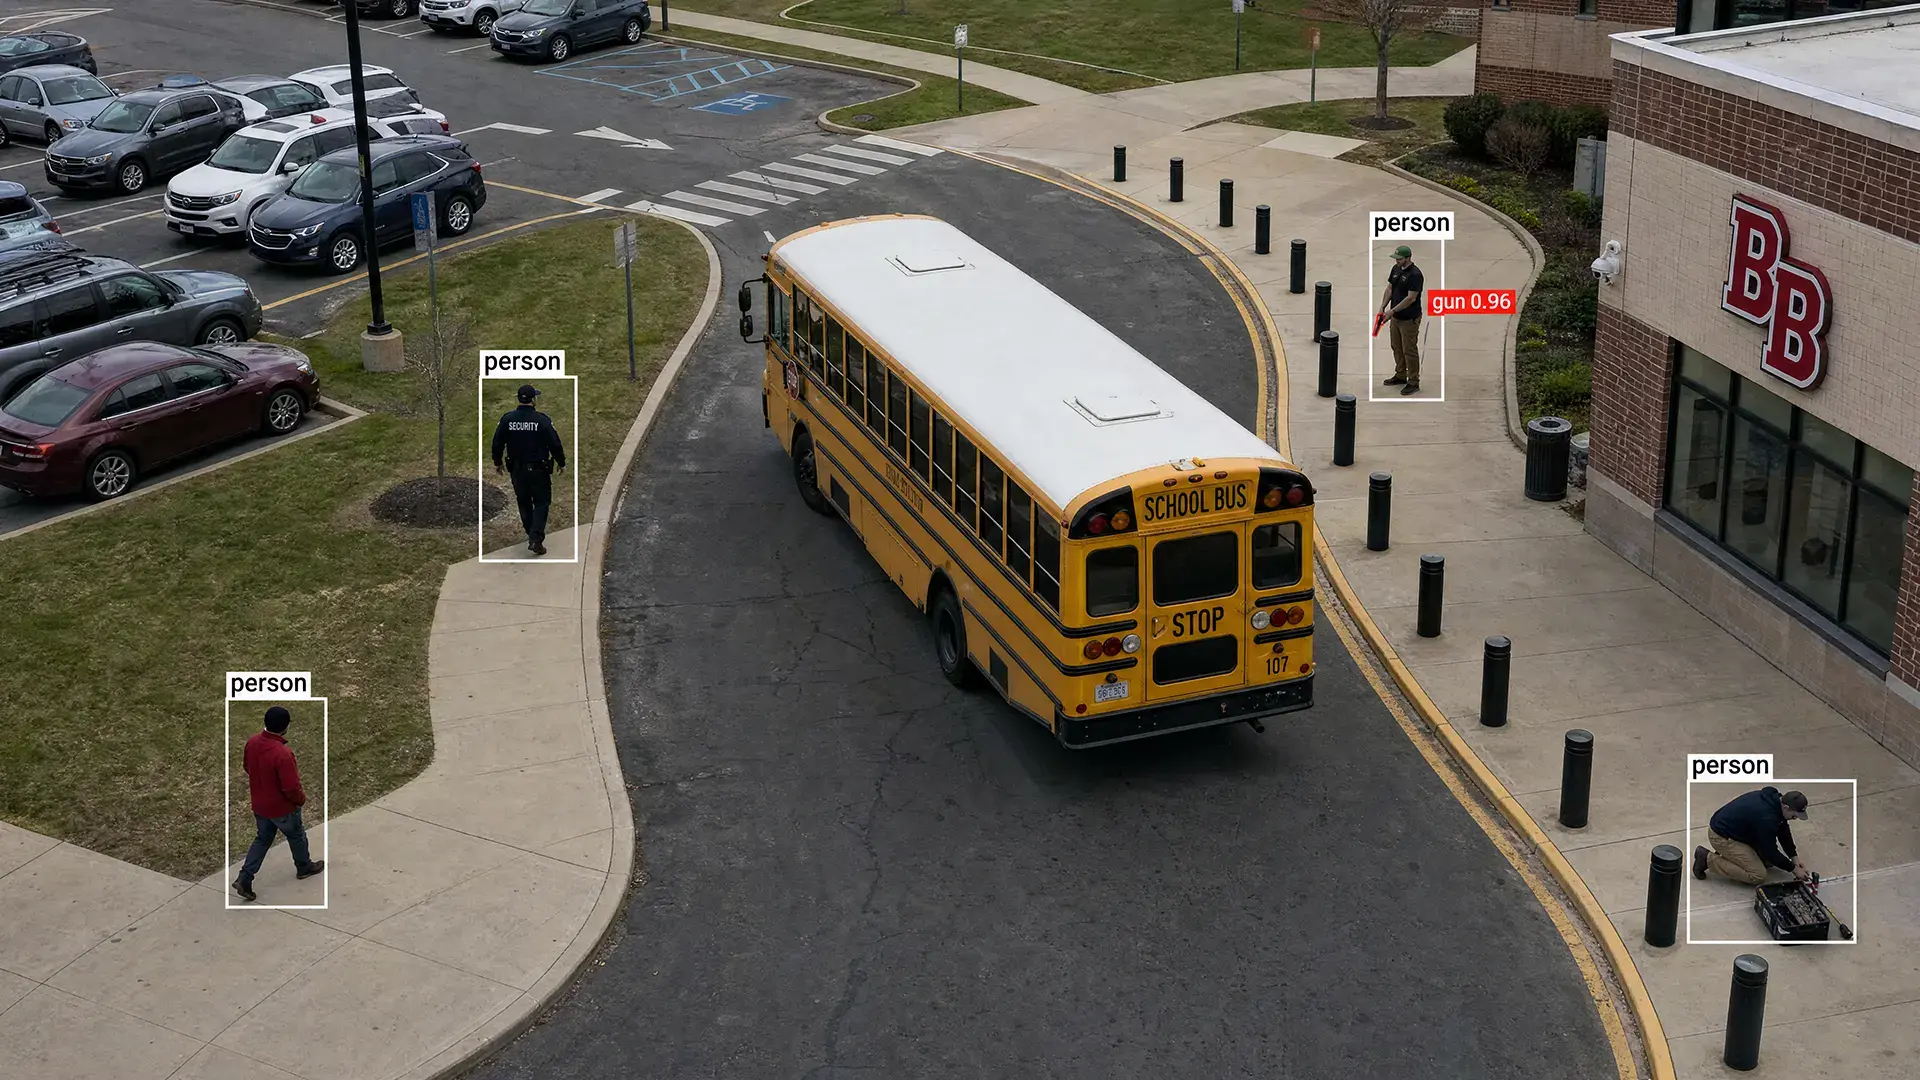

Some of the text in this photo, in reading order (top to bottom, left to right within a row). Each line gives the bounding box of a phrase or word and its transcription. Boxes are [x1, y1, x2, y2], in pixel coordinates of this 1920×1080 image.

[508, 421, 539, 431] SECURITY
[1144, 483, 1247, 522] SCHOOL BUS
[1172, 606, 1225, 638] STOP
[1265, 655, 1289, 676] 107
